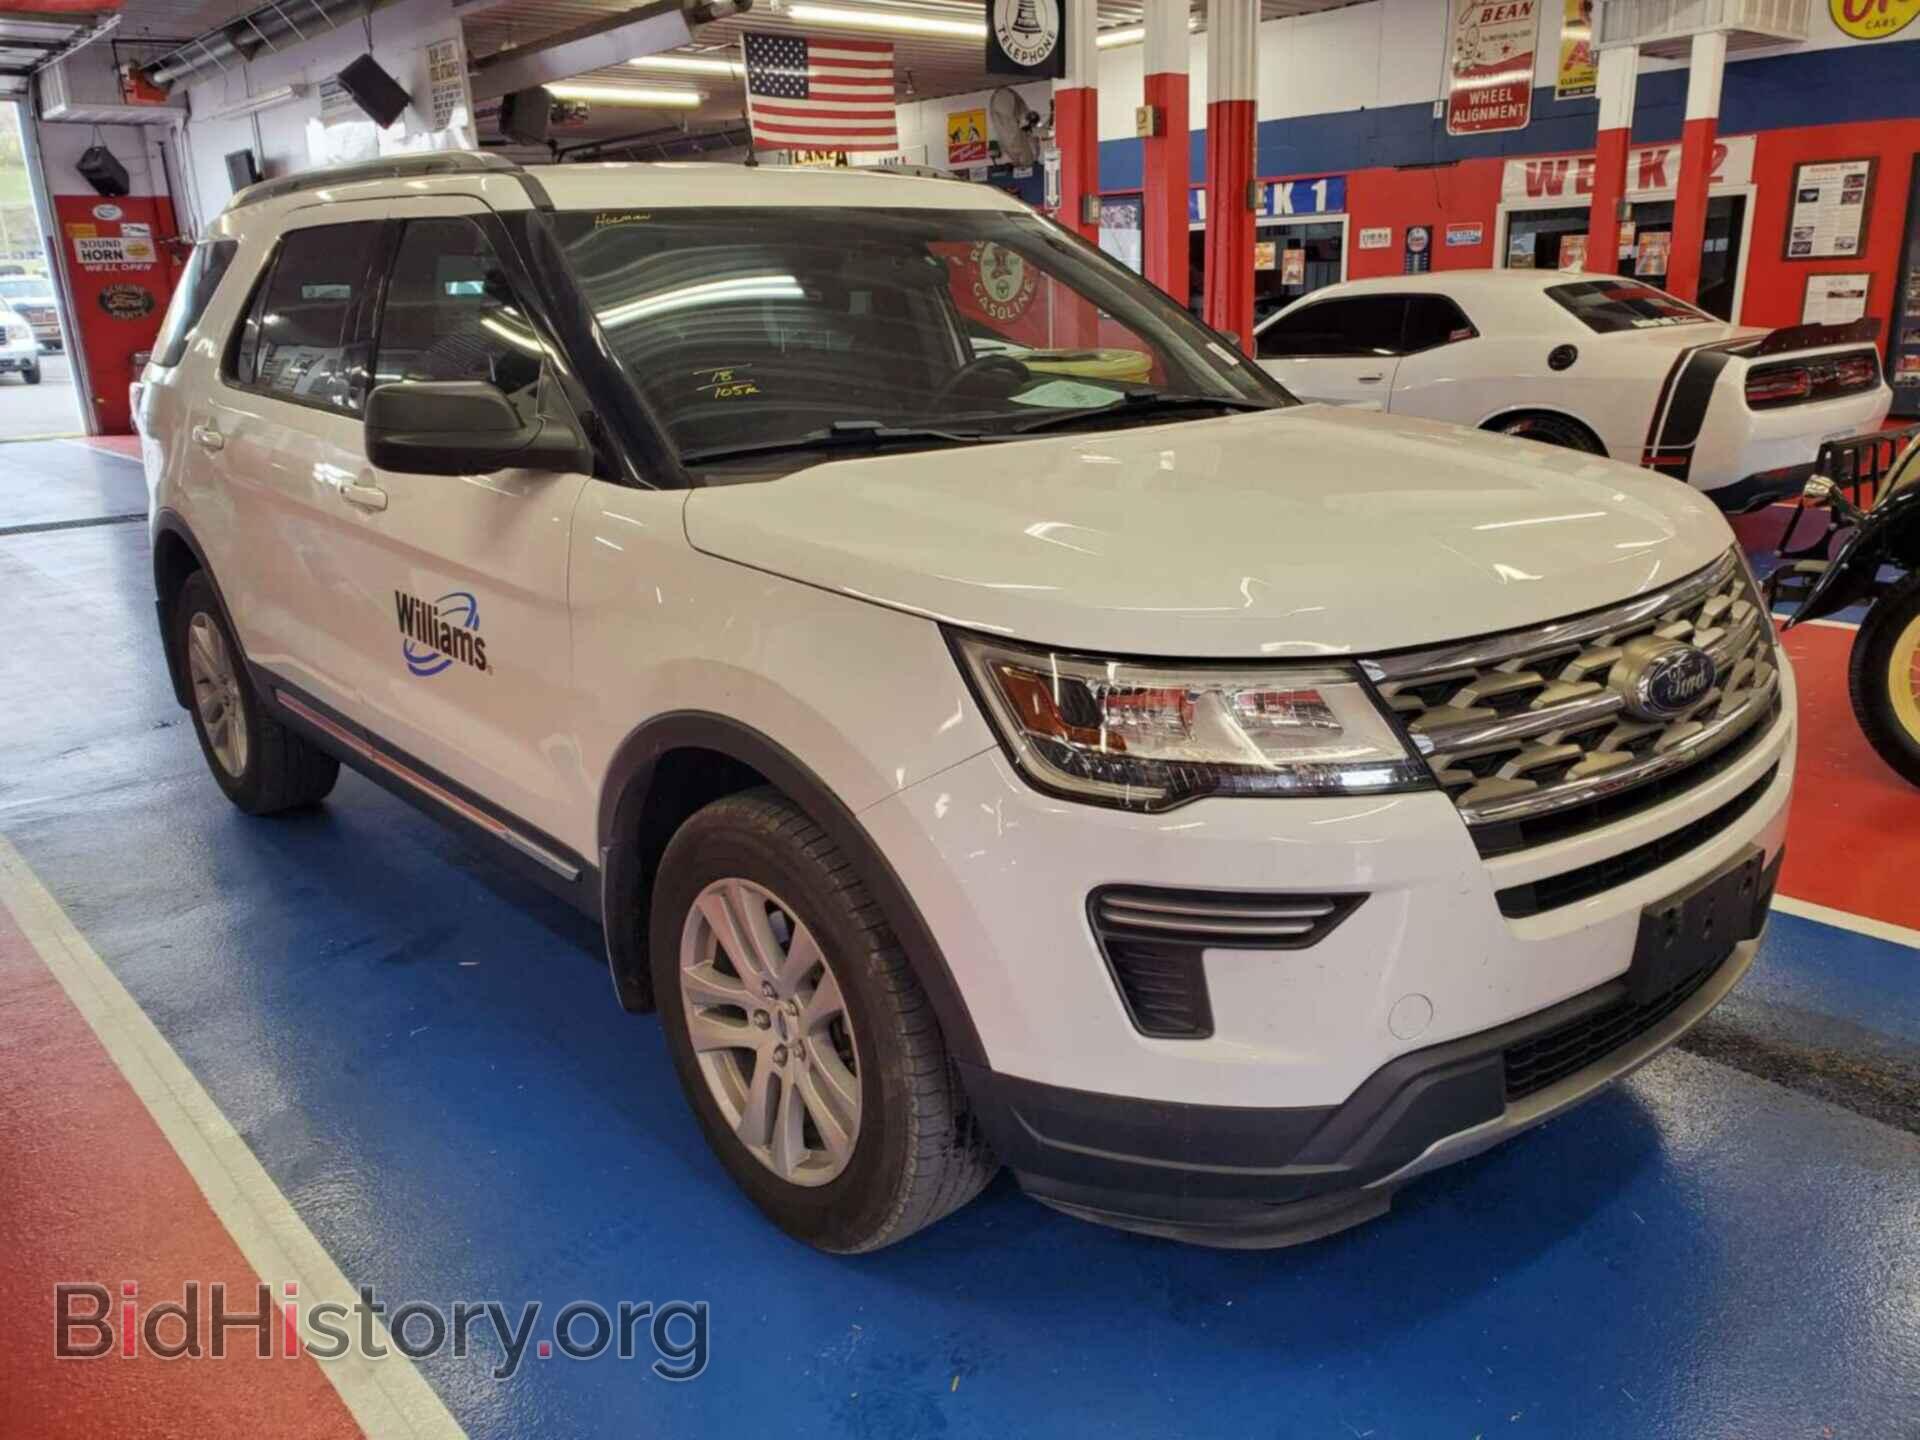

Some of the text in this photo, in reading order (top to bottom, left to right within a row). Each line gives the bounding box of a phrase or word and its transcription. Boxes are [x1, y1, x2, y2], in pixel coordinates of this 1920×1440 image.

[1481, 1, 1533, 23] BEAN
[998, 25, 1055, 62] TELEPHONE
[1469, 88, 1512, 104] WHEEL
[1452, 103, 1526, 123] ALIGNMENT
[1526, 150, 1671, 197] WEK
[1311, 179, 1328, 212] 1
[80, 239, 121, 248] SOUND
[81, 249, 124, 260] HORN
[121, 263, 151, 271] OPEN
[974, 279, 1034, 319] GASOLINE
[394, 589, 487, 671] Williams
[1656, 653, 1706, 700] Ford
